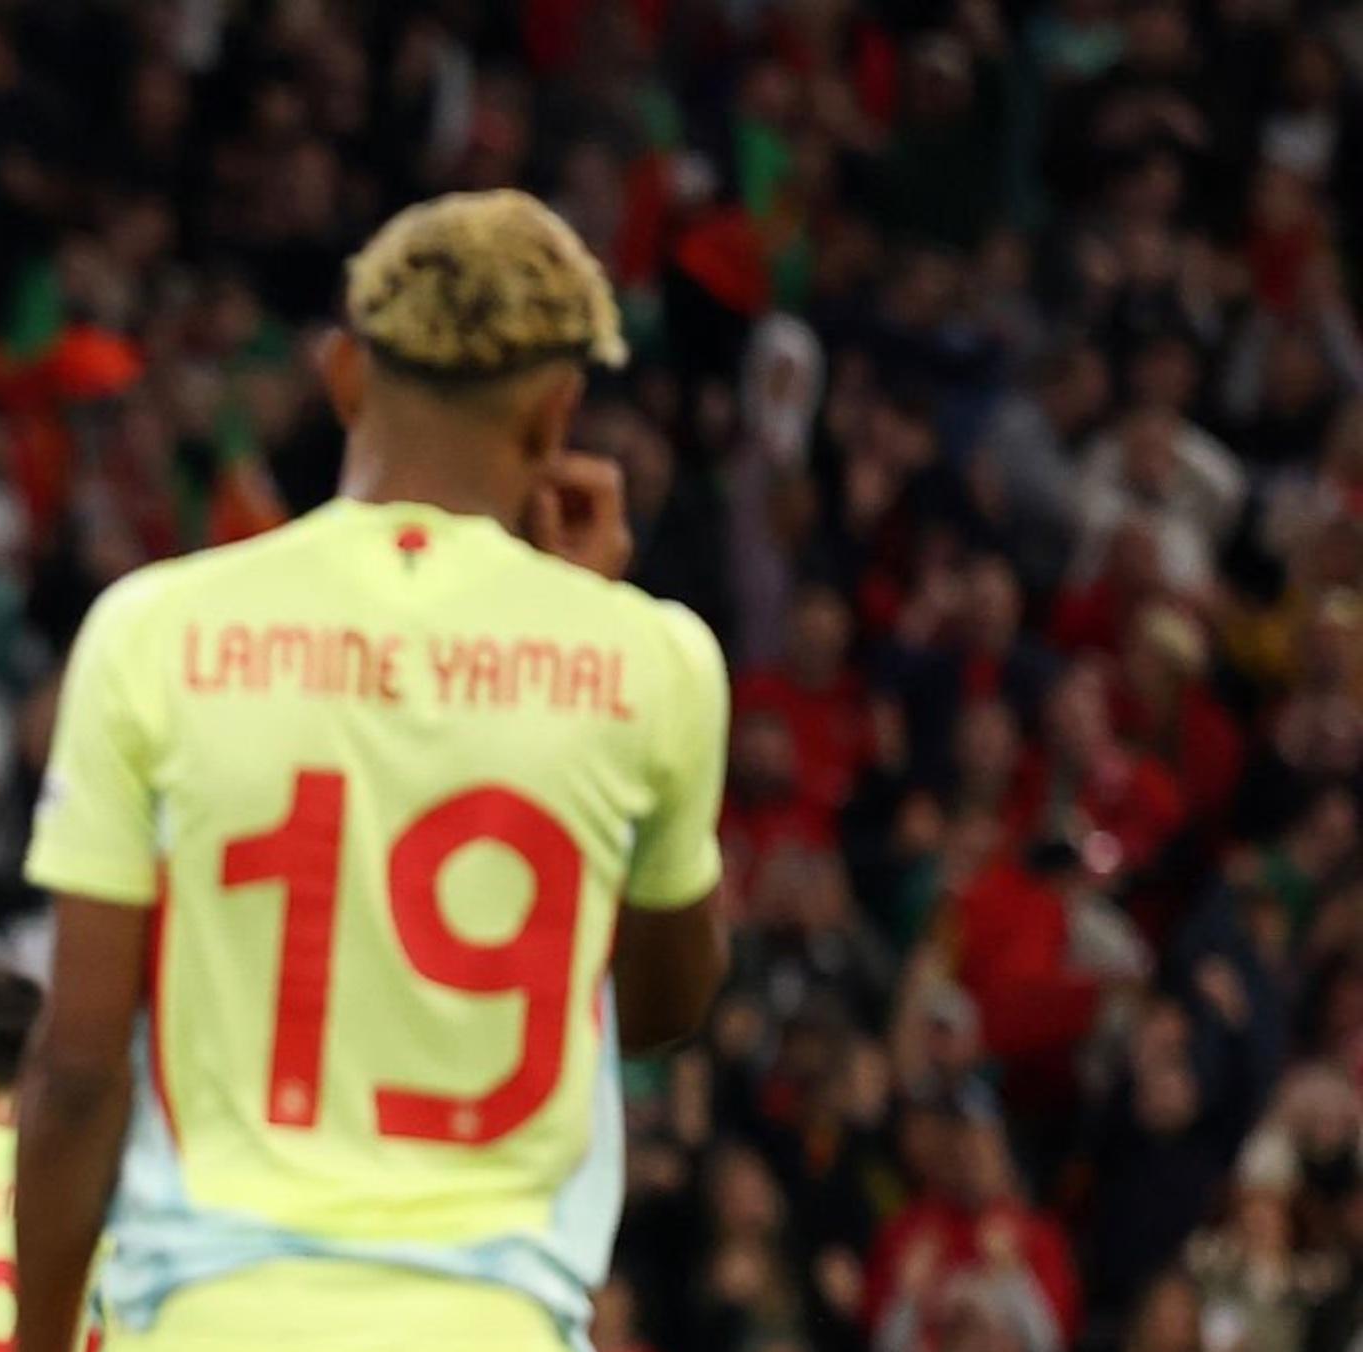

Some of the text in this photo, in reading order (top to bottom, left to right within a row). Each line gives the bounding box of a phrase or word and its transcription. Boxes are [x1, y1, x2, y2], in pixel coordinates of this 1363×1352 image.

[184, 622, 633, 722] LAMINE YAMAL
[220, 768, 587, 1148] 19
